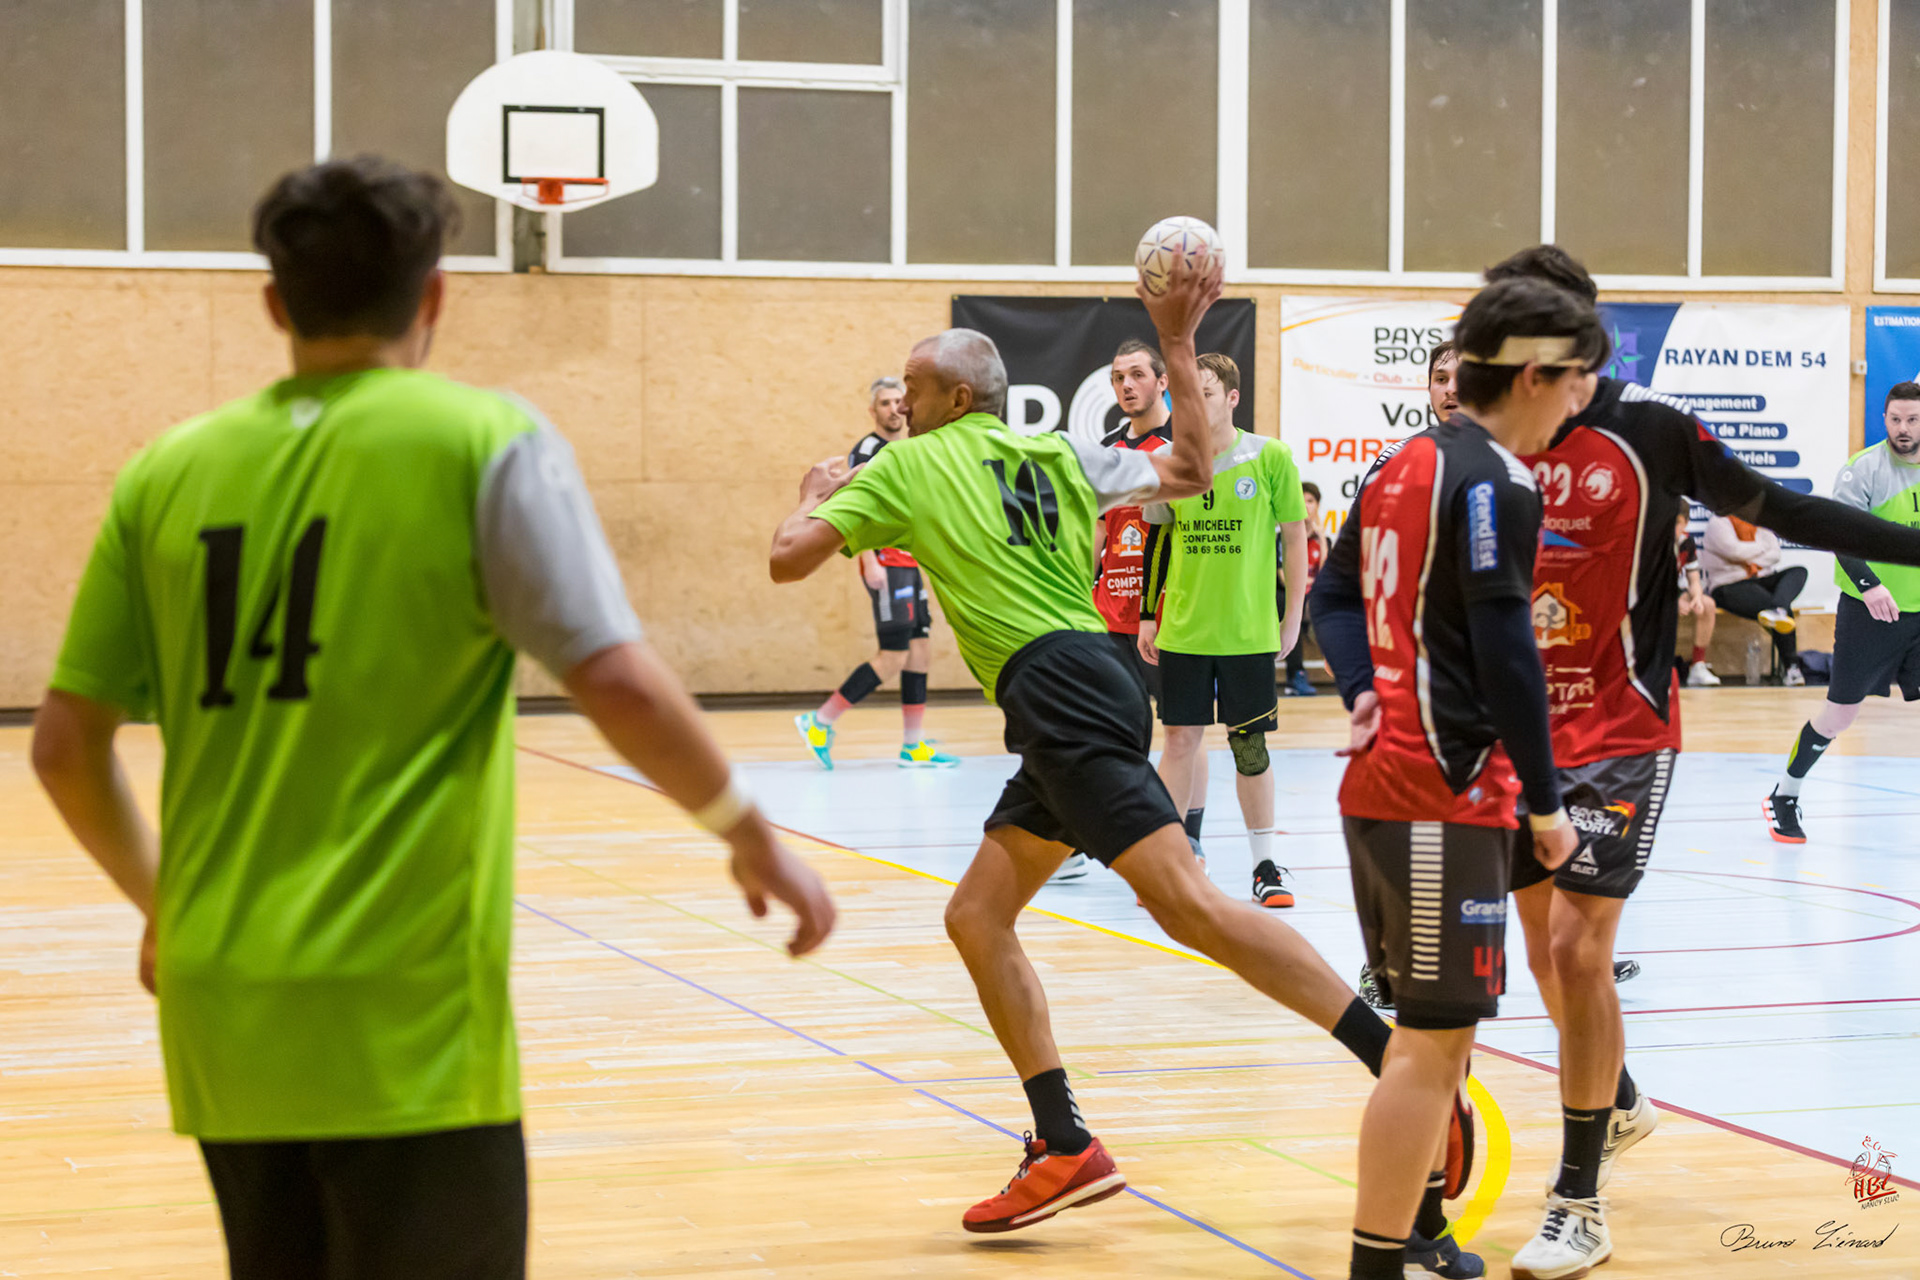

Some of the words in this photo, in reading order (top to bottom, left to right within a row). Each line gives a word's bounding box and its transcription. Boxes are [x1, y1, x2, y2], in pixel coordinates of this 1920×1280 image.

[1374, 326, 1443, 345] PAYS
[1374, 347, 1431, 365] SPO
[1664, 349, 1738, 366] RAYAN
[1745, 350, 1792, 367] DEM
[1801, 352, 1827, 368] 54
[1373, 372, 1402, 384] Club
[1718, 424, 1736, 438] de
[1739, 424, 1780, 438] Piano
[982, 459, 1060, 553] 10
[1202, 489, 1215, 511] 9
[1475, 483, 1497, 538] Grand
[1193, 519, 1243, 532] MICHELET
[1183, 534, 1231, 543] CONFLANS
[1186, 545, 1198, 554] 38
[1201, 545, 1211, 554] 69
[1214, 545, 1226, 554] 56
[1229, 545, 1242, 554] 66
[1125, 566, 1136, 574] LE
[197, 515, 328, 710] 14
[1570, 863, 1599, 877] SELECT
